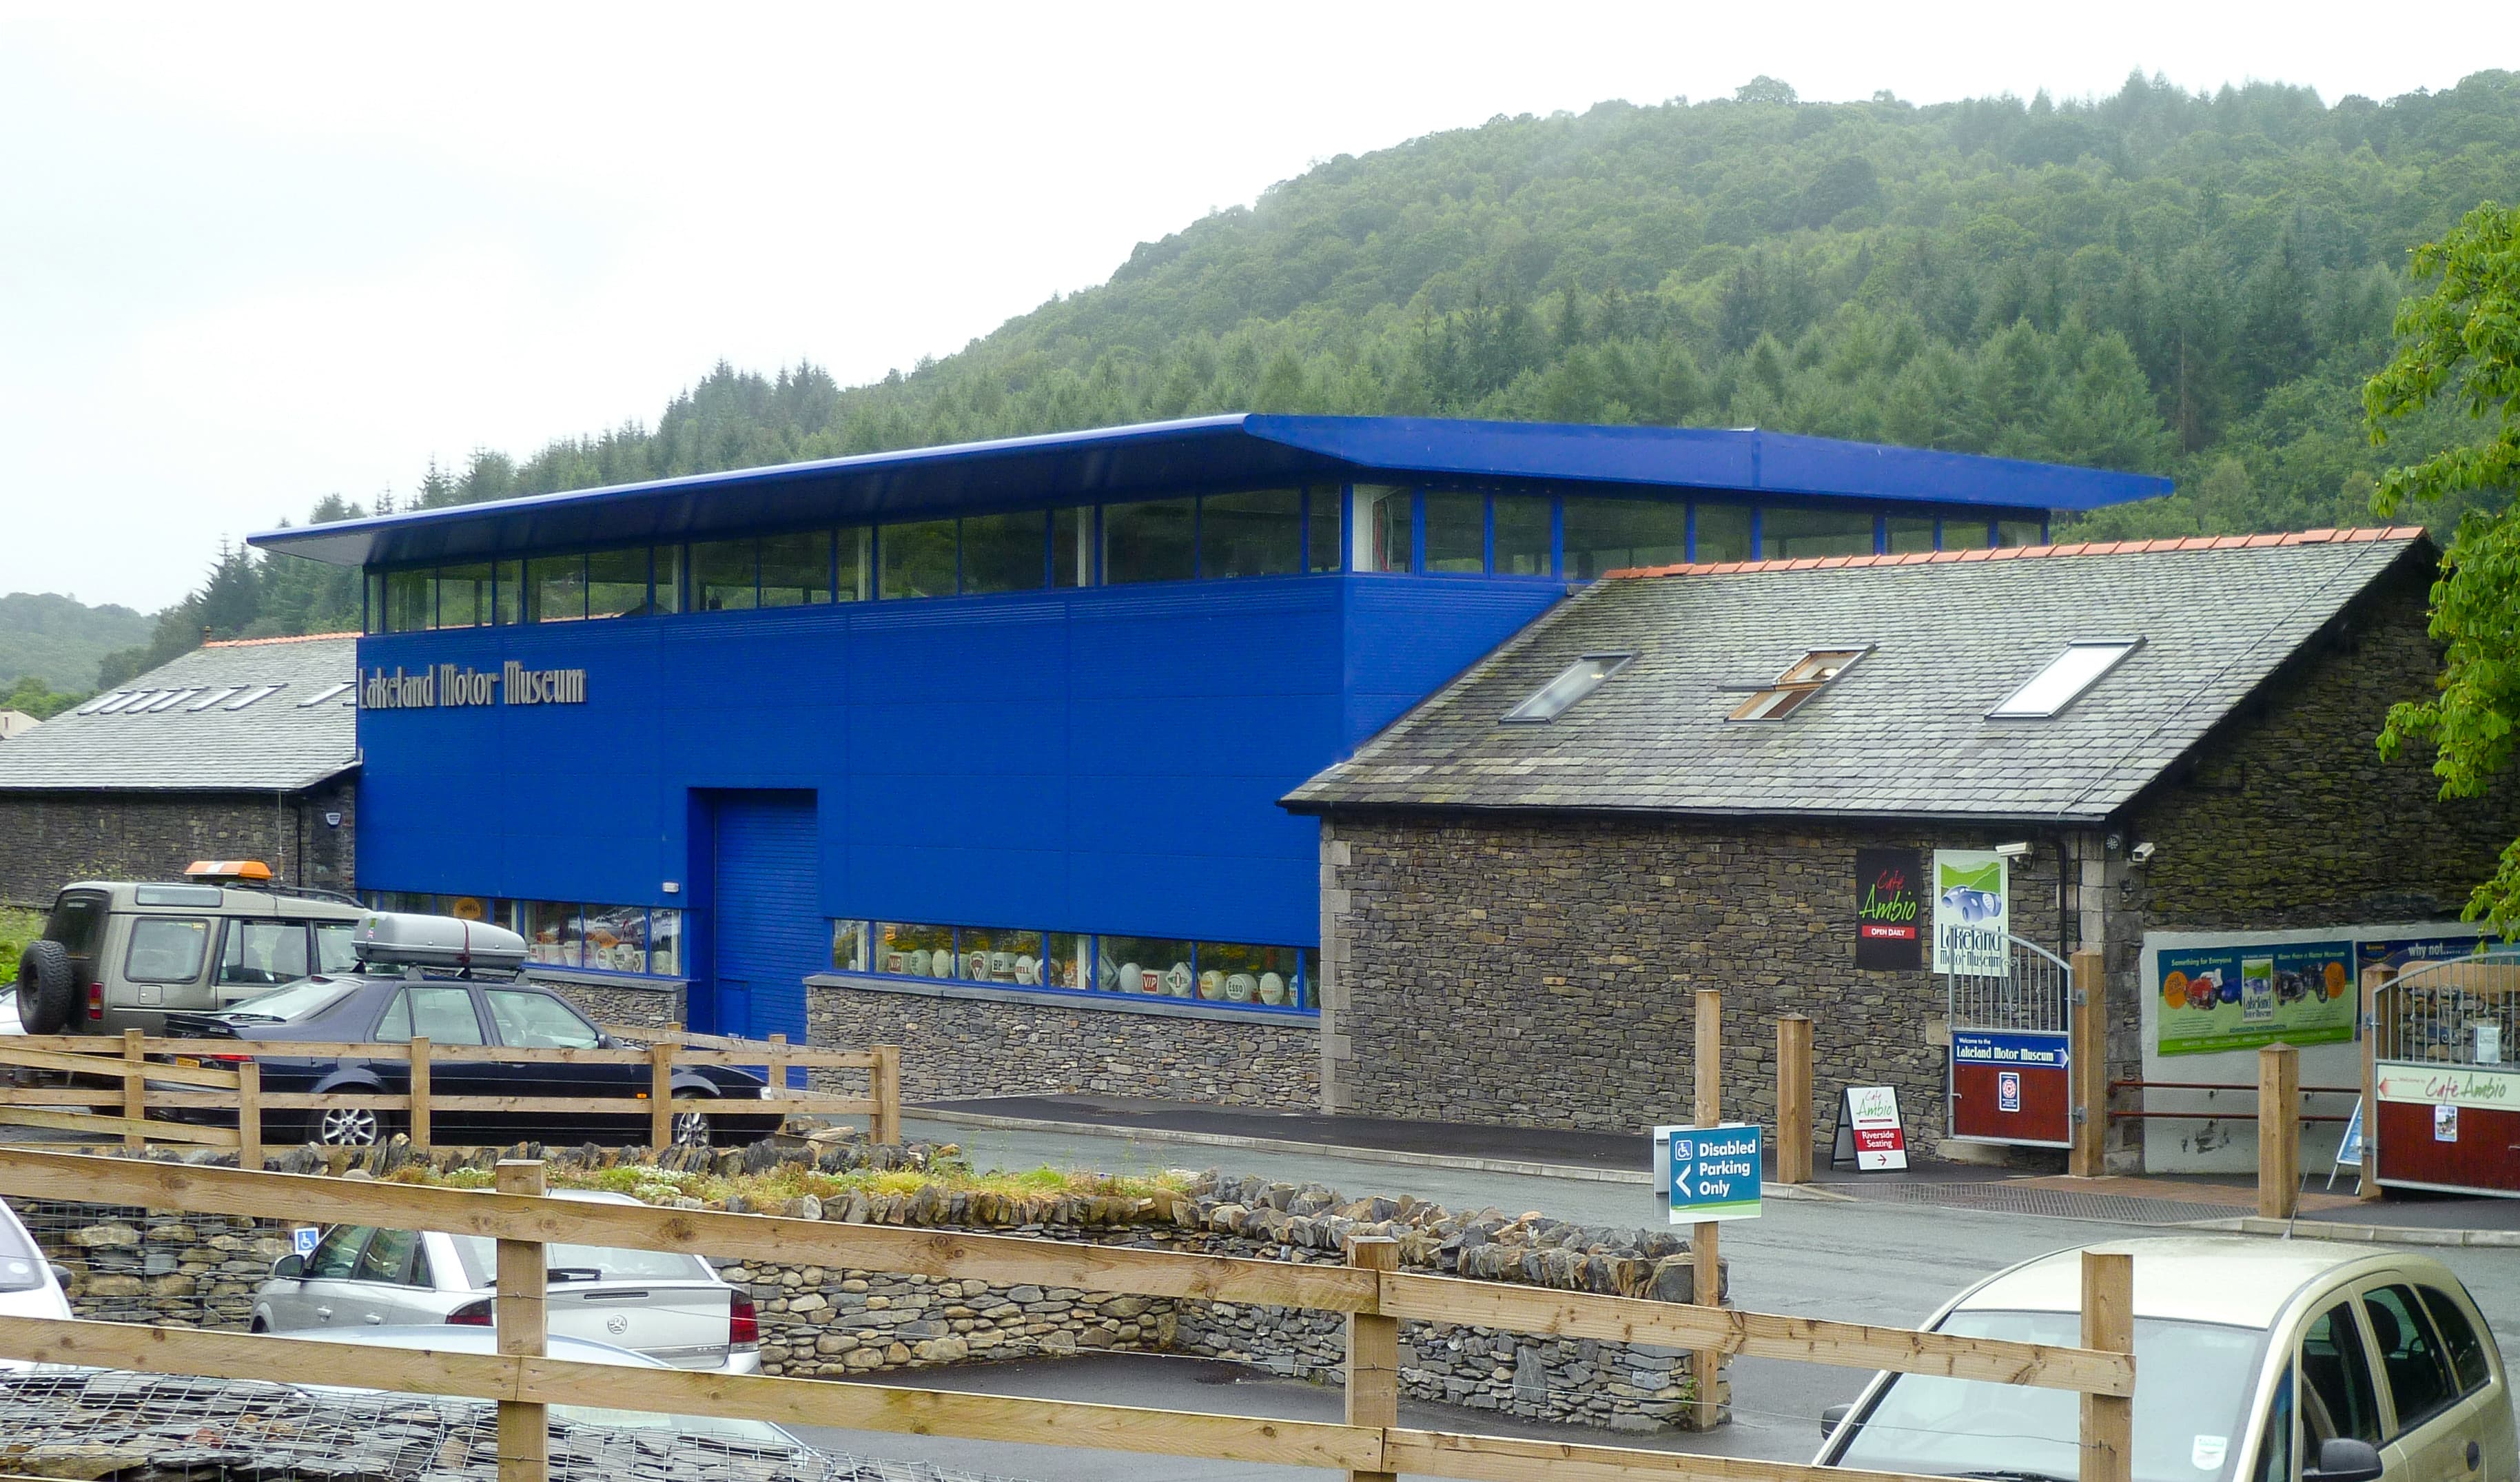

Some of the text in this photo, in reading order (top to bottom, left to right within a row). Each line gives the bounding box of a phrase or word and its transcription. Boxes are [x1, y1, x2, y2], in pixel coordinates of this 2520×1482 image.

[358, 660, 587, 709] Lakeland Motor Museum
[1858, 884, 1916, 922] Ambio
[2408, 943, 2426, 959] why
[890, 957, 901, 968] VIP
[993, 960, 1003, 971] BP
[1143, 976, 1157, 988] VIP
[1957, 1046, 2054, 1062] Lakeland Motor Museum
[2425, 1073, 2508, 1105] Café Ambio
[1856, 1098, 1892, 1117] Ambio
[1862, 1131, 1895, 1139] Riverside
[1699, 1139, 1756, 1157] Disabled
[1867, 1139, 1894, 1149] Seating
[1699, 1160, 1750, 1177] Parking
[1699, 1179, 1731, 1197] Only
